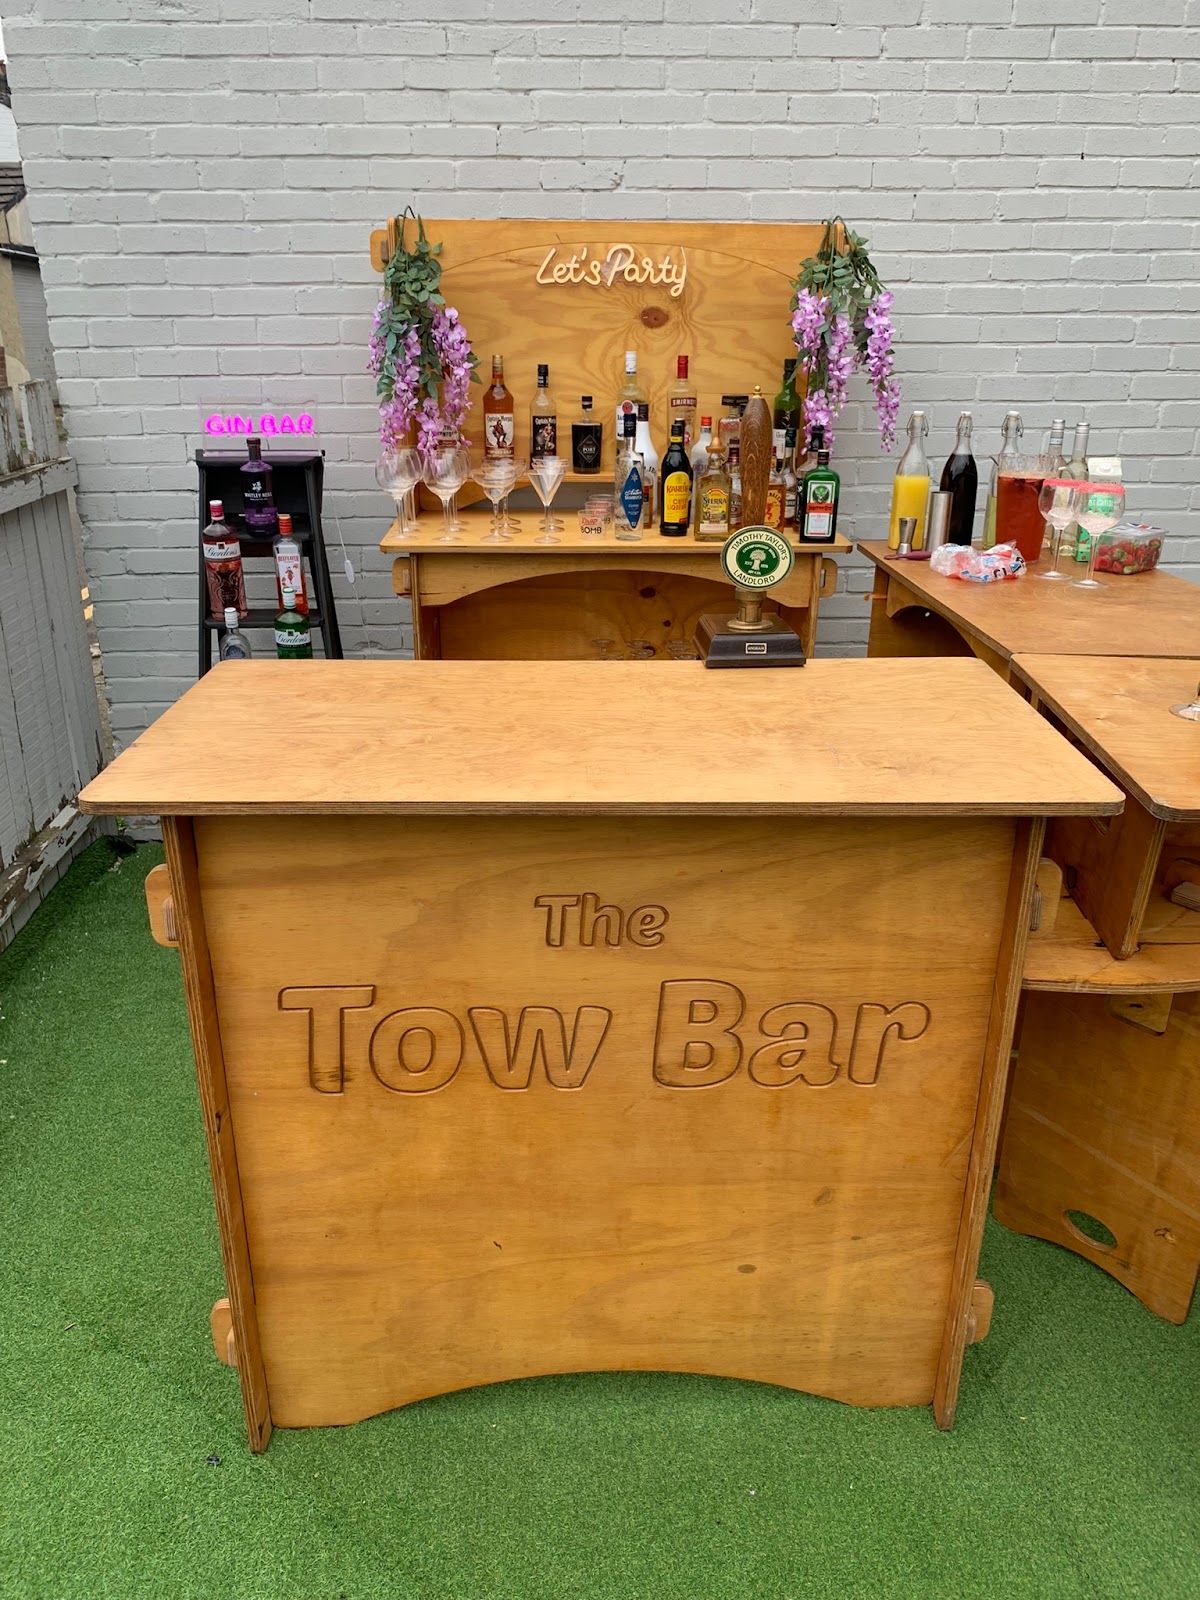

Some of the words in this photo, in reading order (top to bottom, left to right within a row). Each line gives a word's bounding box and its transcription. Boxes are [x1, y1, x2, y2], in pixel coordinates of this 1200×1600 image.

[536, 247, 601, 286] Let's
[606, 244, 687, 297] Party
[206, 413, 253, 437] GIN
[260, 413, 315, 437] BAR
[702, 497, 727, 505] SIERRA
[580, 526, 602, 534] BOMB
[205, 546, 239, 557] Gordon's
[731, 533, 764, 551] TIMOTHY
[764, 535, 789, 561] TAYLOR'S
[733, 569, 776, 585] LANDLORD
[277, 633, 308, 643] Gordon's
[534, 892, 670, 949] The
[277, 983, 613, 1096] Tow
[652, 978, 931, 1089] Bar
